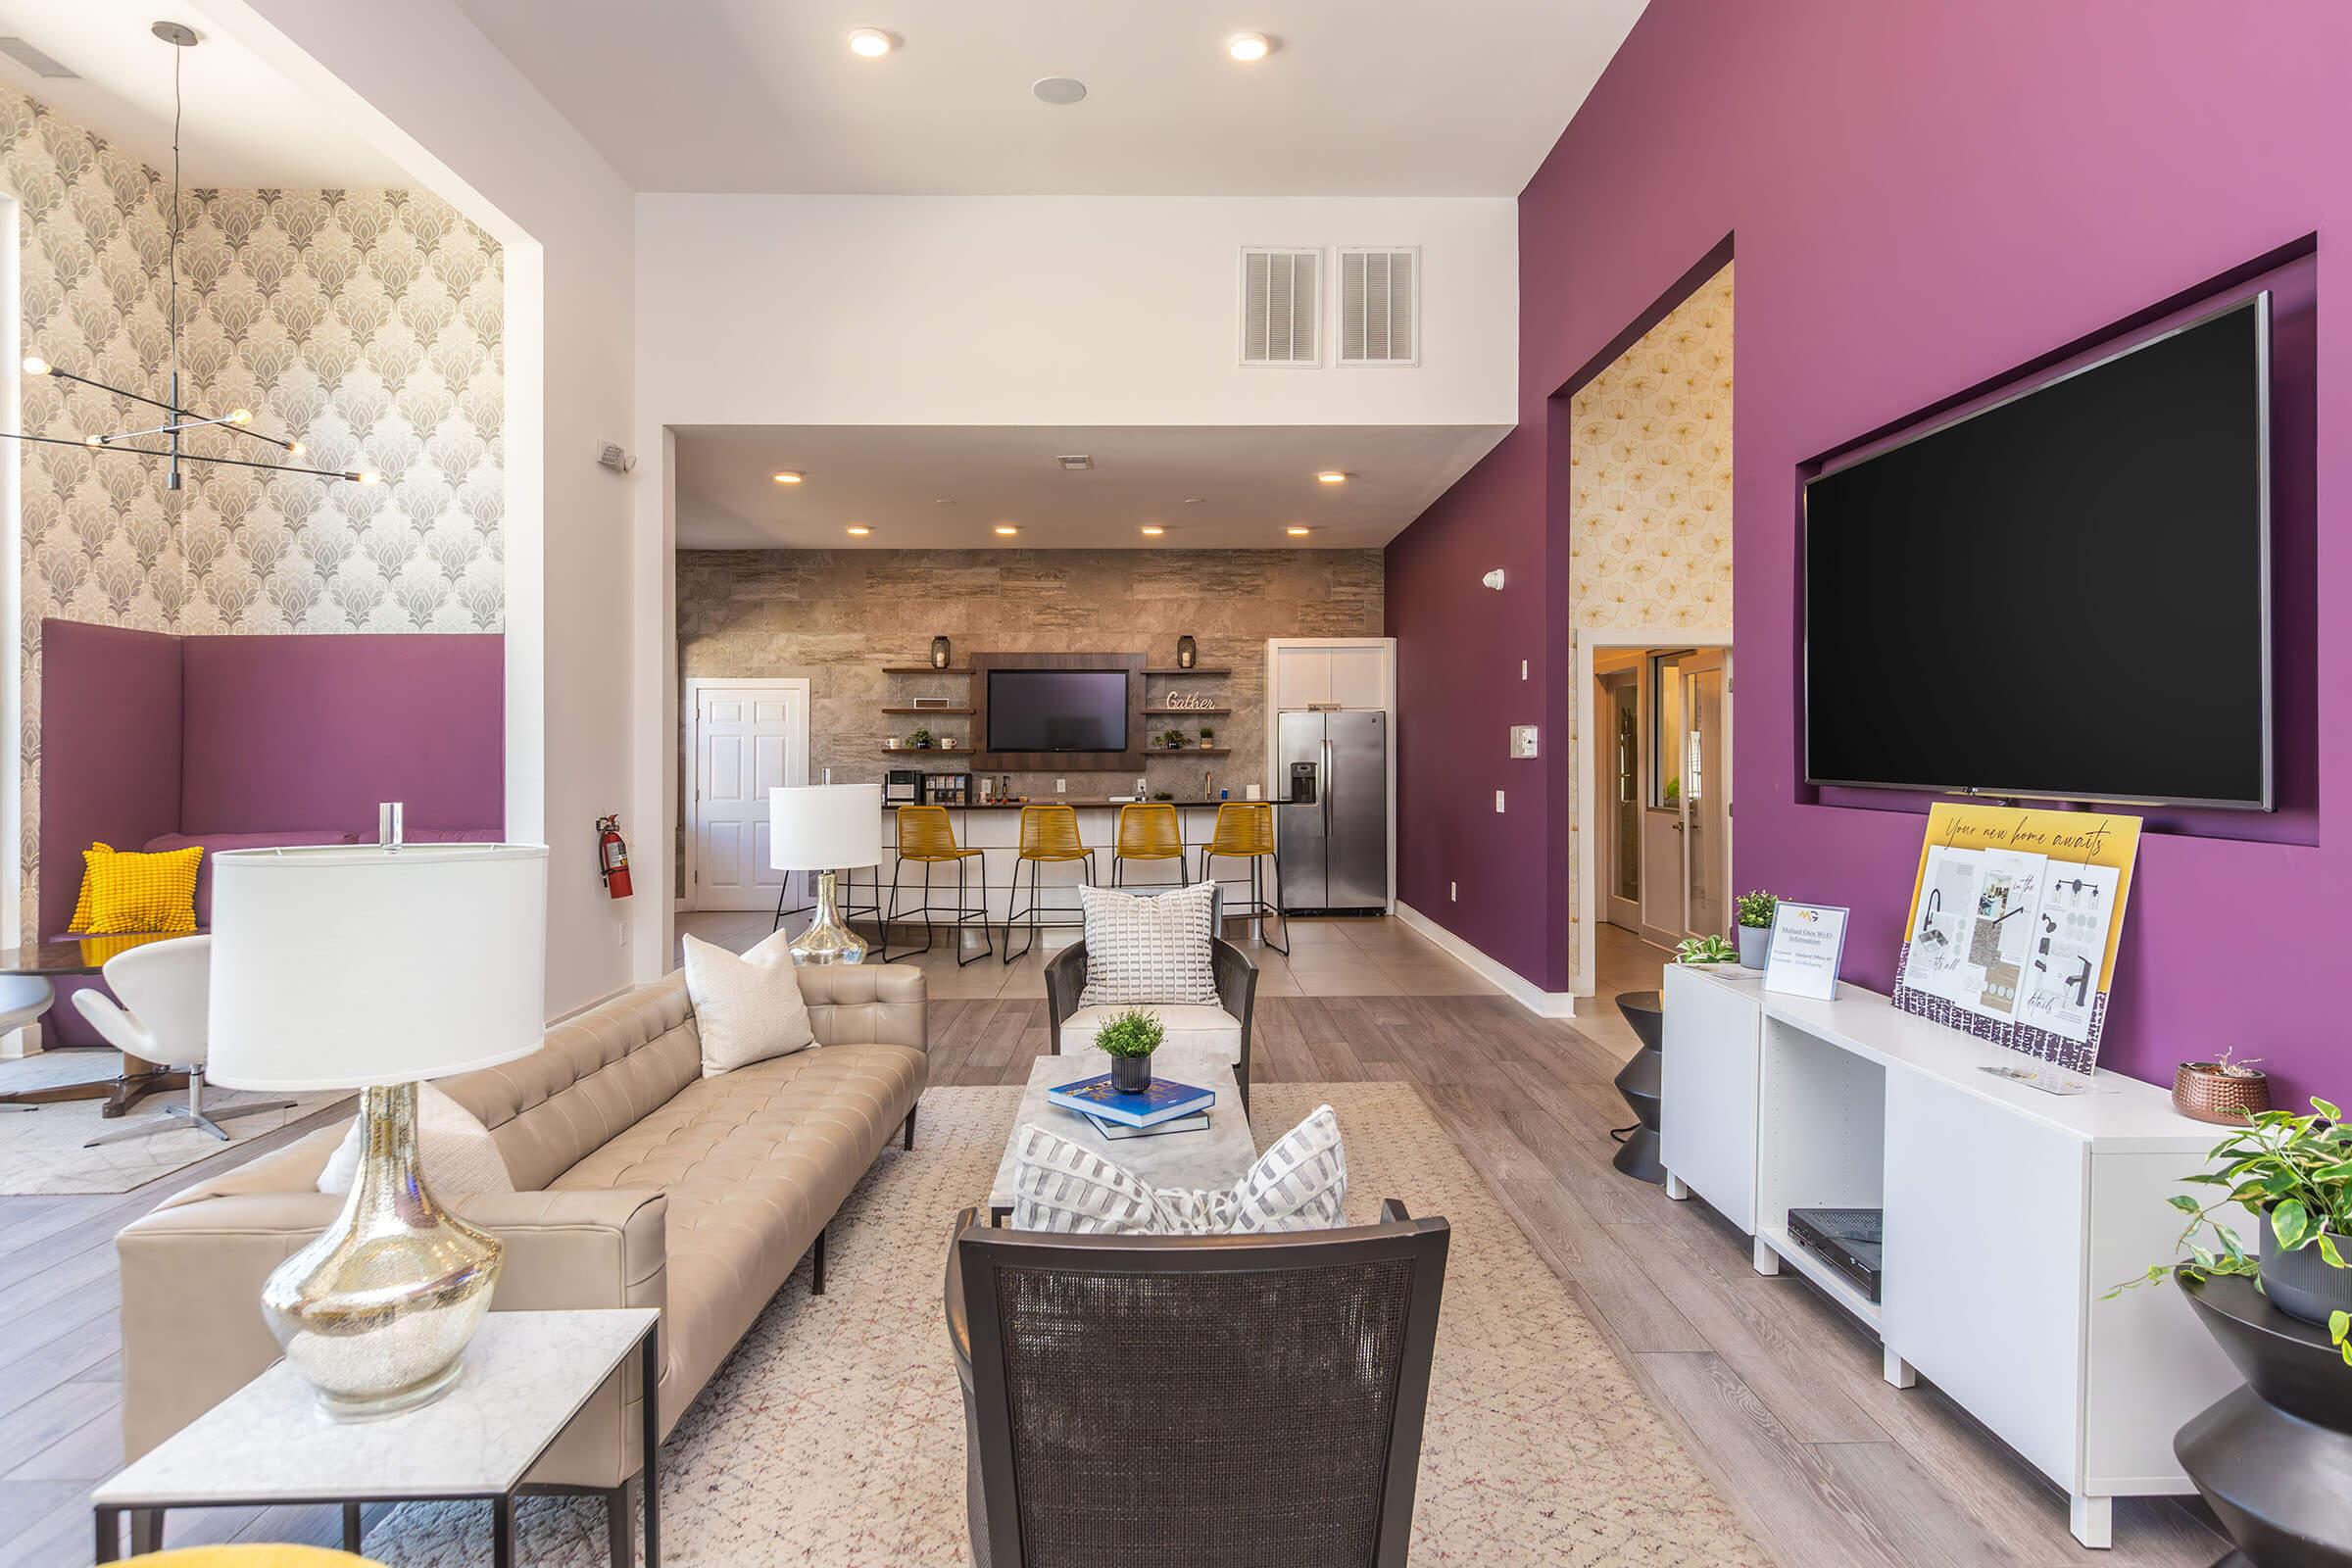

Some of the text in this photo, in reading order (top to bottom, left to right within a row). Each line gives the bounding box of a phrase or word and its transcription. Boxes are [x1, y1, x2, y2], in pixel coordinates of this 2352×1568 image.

[1166, 691, 1215, 710] Gather
[1944, 816, 2110, 870] Your new home awaits
[1944, 958, 1960, 971] all
